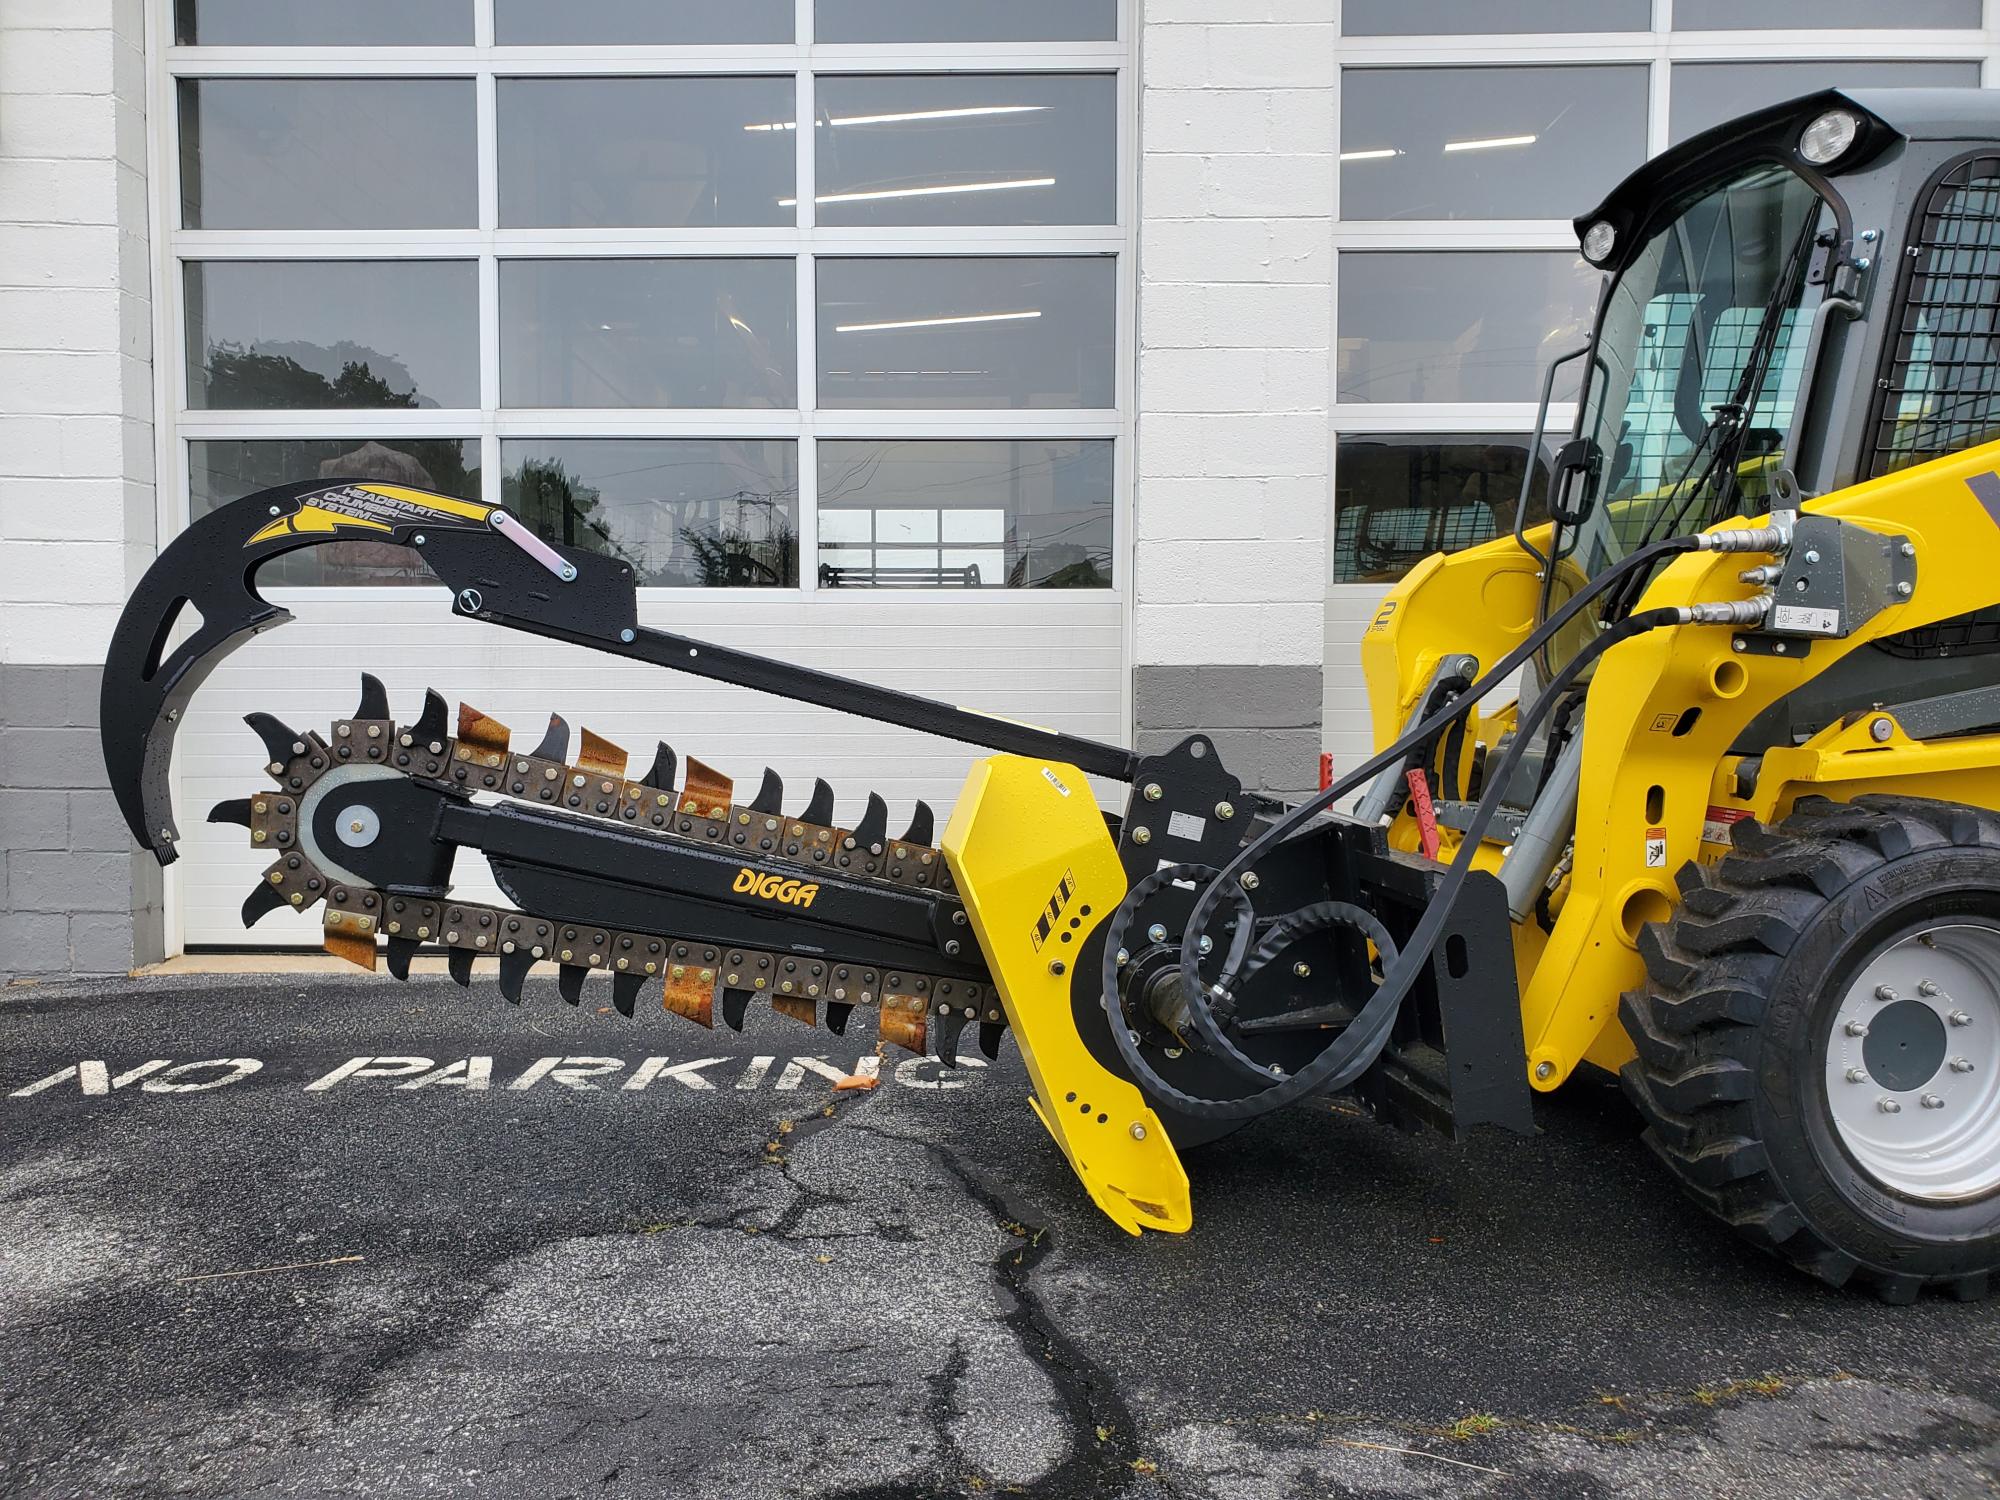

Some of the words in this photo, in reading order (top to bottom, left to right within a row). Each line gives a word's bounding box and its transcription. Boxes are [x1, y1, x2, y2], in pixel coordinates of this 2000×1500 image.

[305, 497, 373, 520] SYSTEM
[322, 491, 401, 518] CRUMBER
[342, 486, 439, 518] HEADSTART
[732, 867, 820, 908] DIGGA
[8, 1057, 264, 1098] NO
[303, 1054, 994, 1093] PARKING
